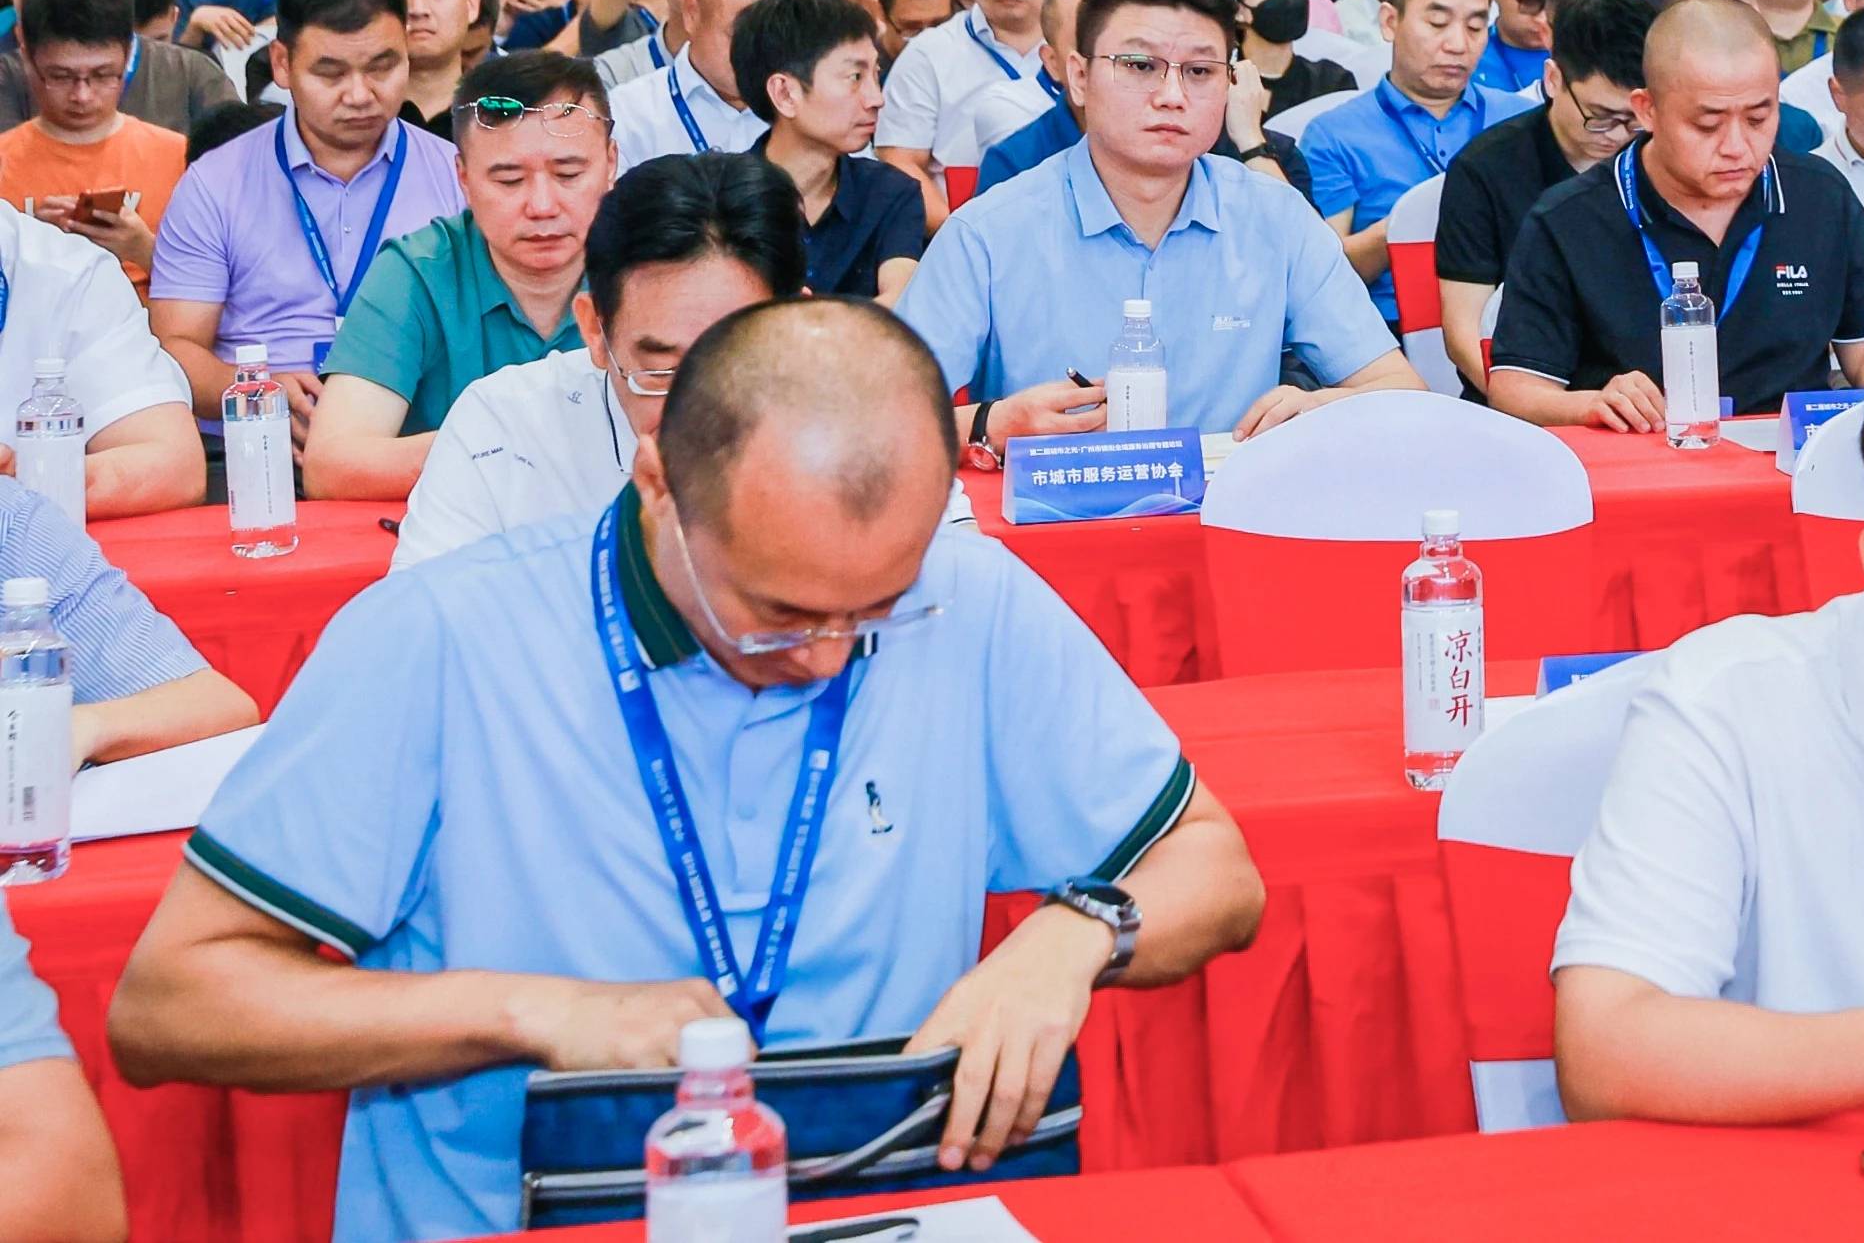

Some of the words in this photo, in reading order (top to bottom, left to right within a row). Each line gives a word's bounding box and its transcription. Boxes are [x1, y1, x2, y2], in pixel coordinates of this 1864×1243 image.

[1775, 263, 1808, 279] FILA
[1031, 461, 1184, 487] 市城市服务运营协会
[1444, 629, 1474, 728] 凉白开
